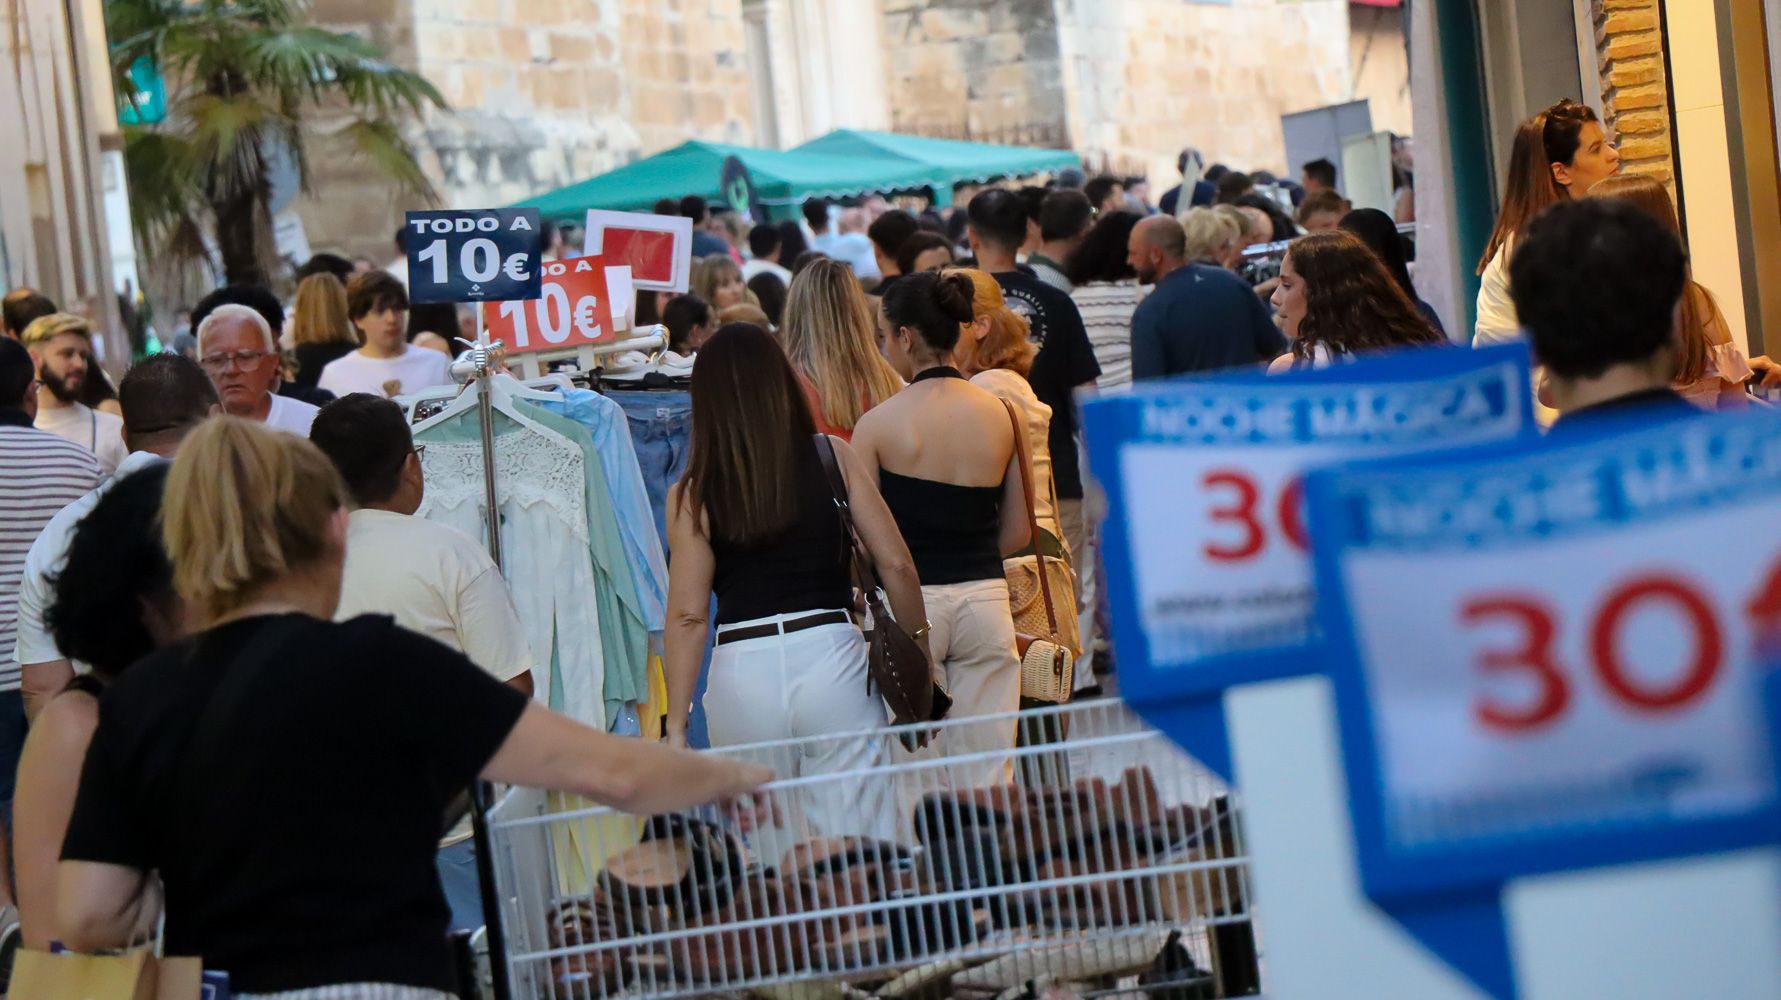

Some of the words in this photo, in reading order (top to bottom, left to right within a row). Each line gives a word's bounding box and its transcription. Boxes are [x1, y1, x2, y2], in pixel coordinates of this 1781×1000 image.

[410, 217, 500, 234] TODO
[509, 216, 532, 231] A
[418, 238, 530, 284] 10€
[574, 260, 593, 273] A
[500, 282, 602, 348] 10€
[1011, 288, 1046, 317] QUALITY
[1143, 401, 1294, 438] NOCHE
